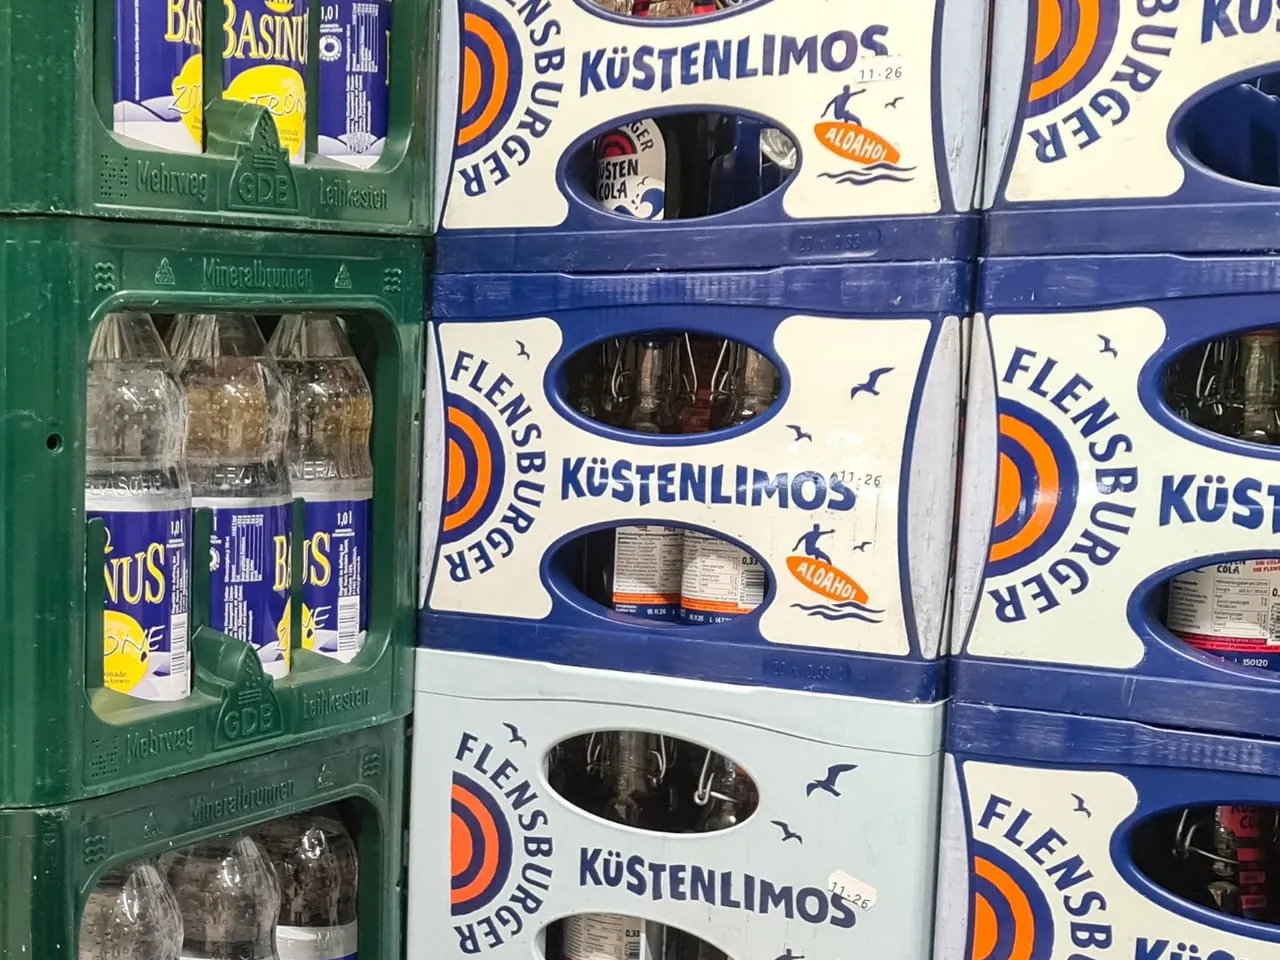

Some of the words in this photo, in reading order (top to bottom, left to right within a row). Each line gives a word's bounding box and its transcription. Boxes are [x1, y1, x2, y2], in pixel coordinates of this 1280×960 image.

[579, 24, 890, 98] KÜSTENLIMOS
[458, 0, 565, 199] NSBURGER
[136, 160, 208, 200] Mehrweg
[239, 171, 289, 203] GDB
[320, 177, 389, 210] Leihkasten
[202, 257, 314, 292] Mineralbrunnen
[444, 350, 547, 583] FLENSBURGER
[560, 456, 856, 512] KÜSTENLIMOS
[987, 346, 1139, 624] FLENSBURGER
[223, 707, 271, 739] GDB
[302, 686, 370, 721] Leihkasten
[125, 724, 194, 763] Mehrweg
[189, 780, 294, 827] Mineralbrunnen
[453, 731, 554, 955] FLENSBURGER
[579, 846, 857, 929] KÜSTENLIMOS
